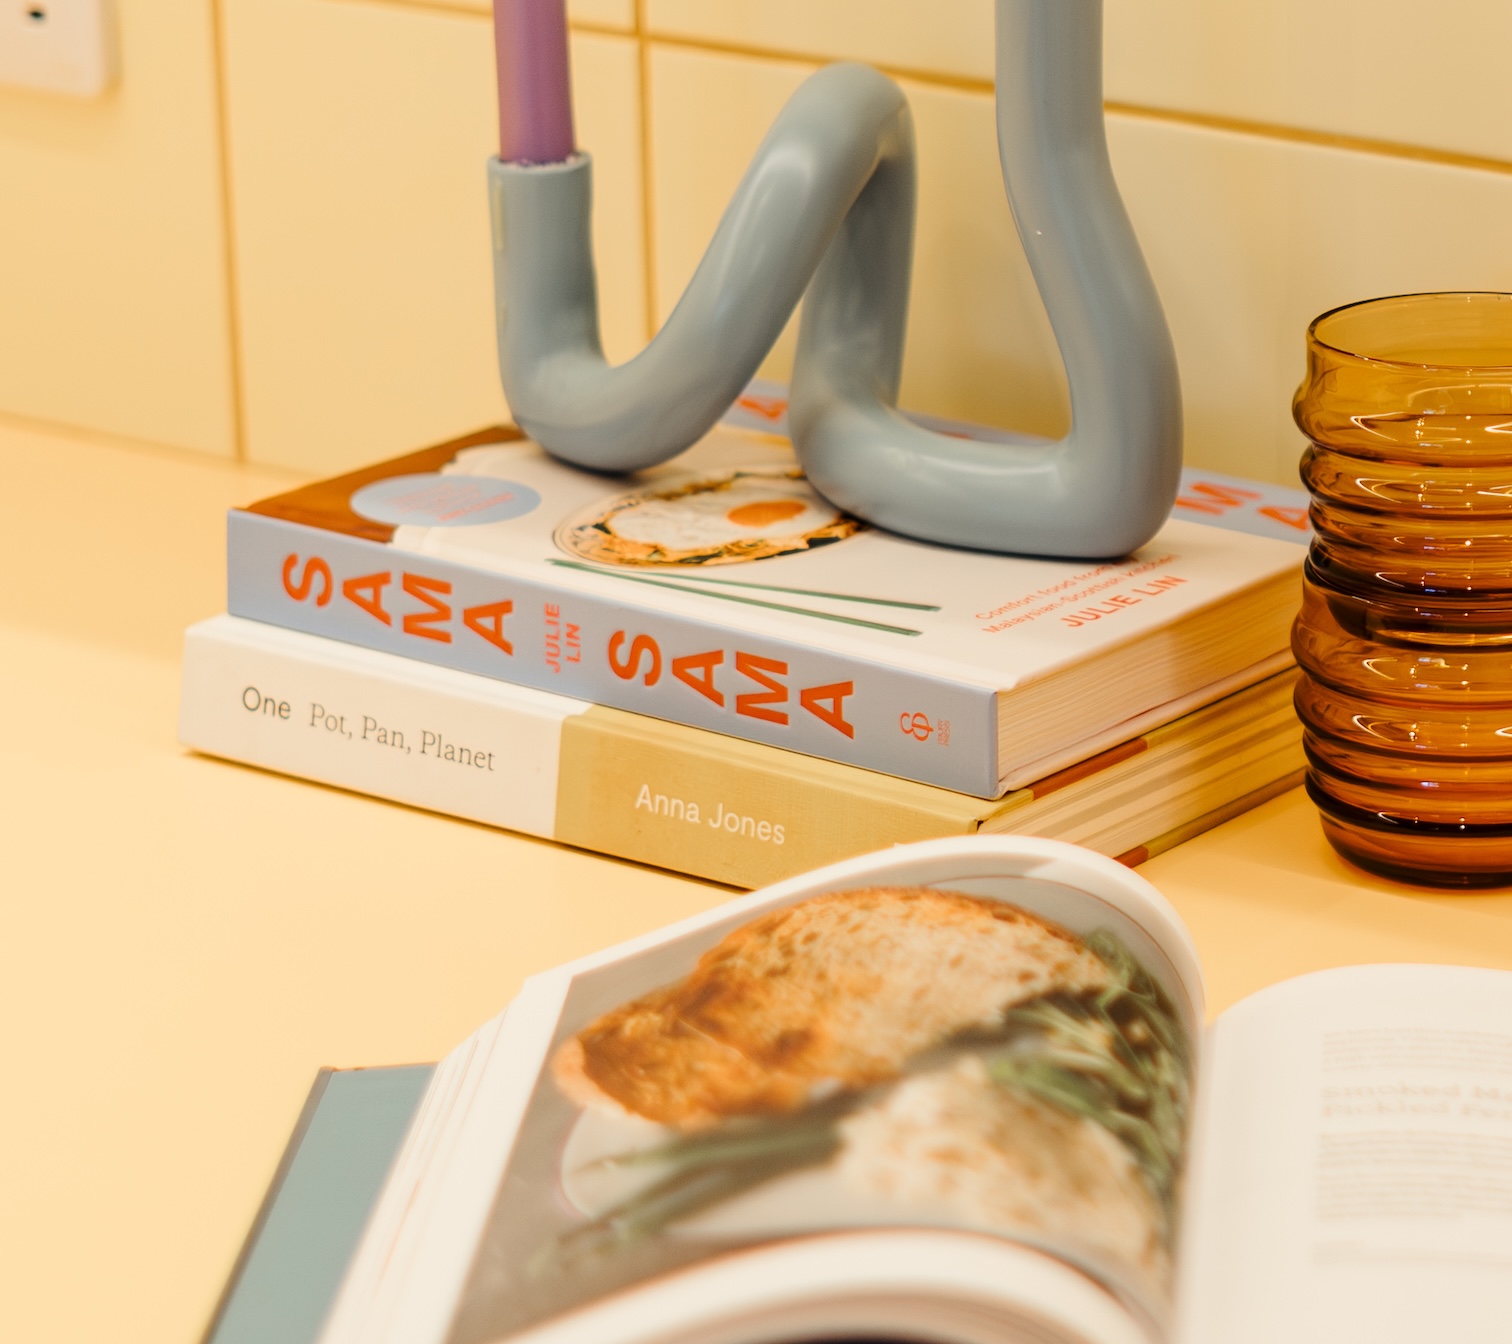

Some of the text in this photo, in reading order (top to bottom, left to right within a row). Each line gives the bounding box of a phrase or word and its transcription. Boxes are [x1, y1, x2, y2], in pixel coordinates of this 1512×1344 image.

[975, 593, 1039, 621] Comfort
[1037, 579, 1077, 599] food
[1060, 575, 1189, 628] JULIE LIN
[282, 552, 855, 740] SAMA SAMA
[543, 602, 561, 674] JULIE
[564, 622, 581, 663] LIN
[242, 686, 496, 772] One Pot, Pan, Planet
[635, 784, 785, 845] Anna Jones
